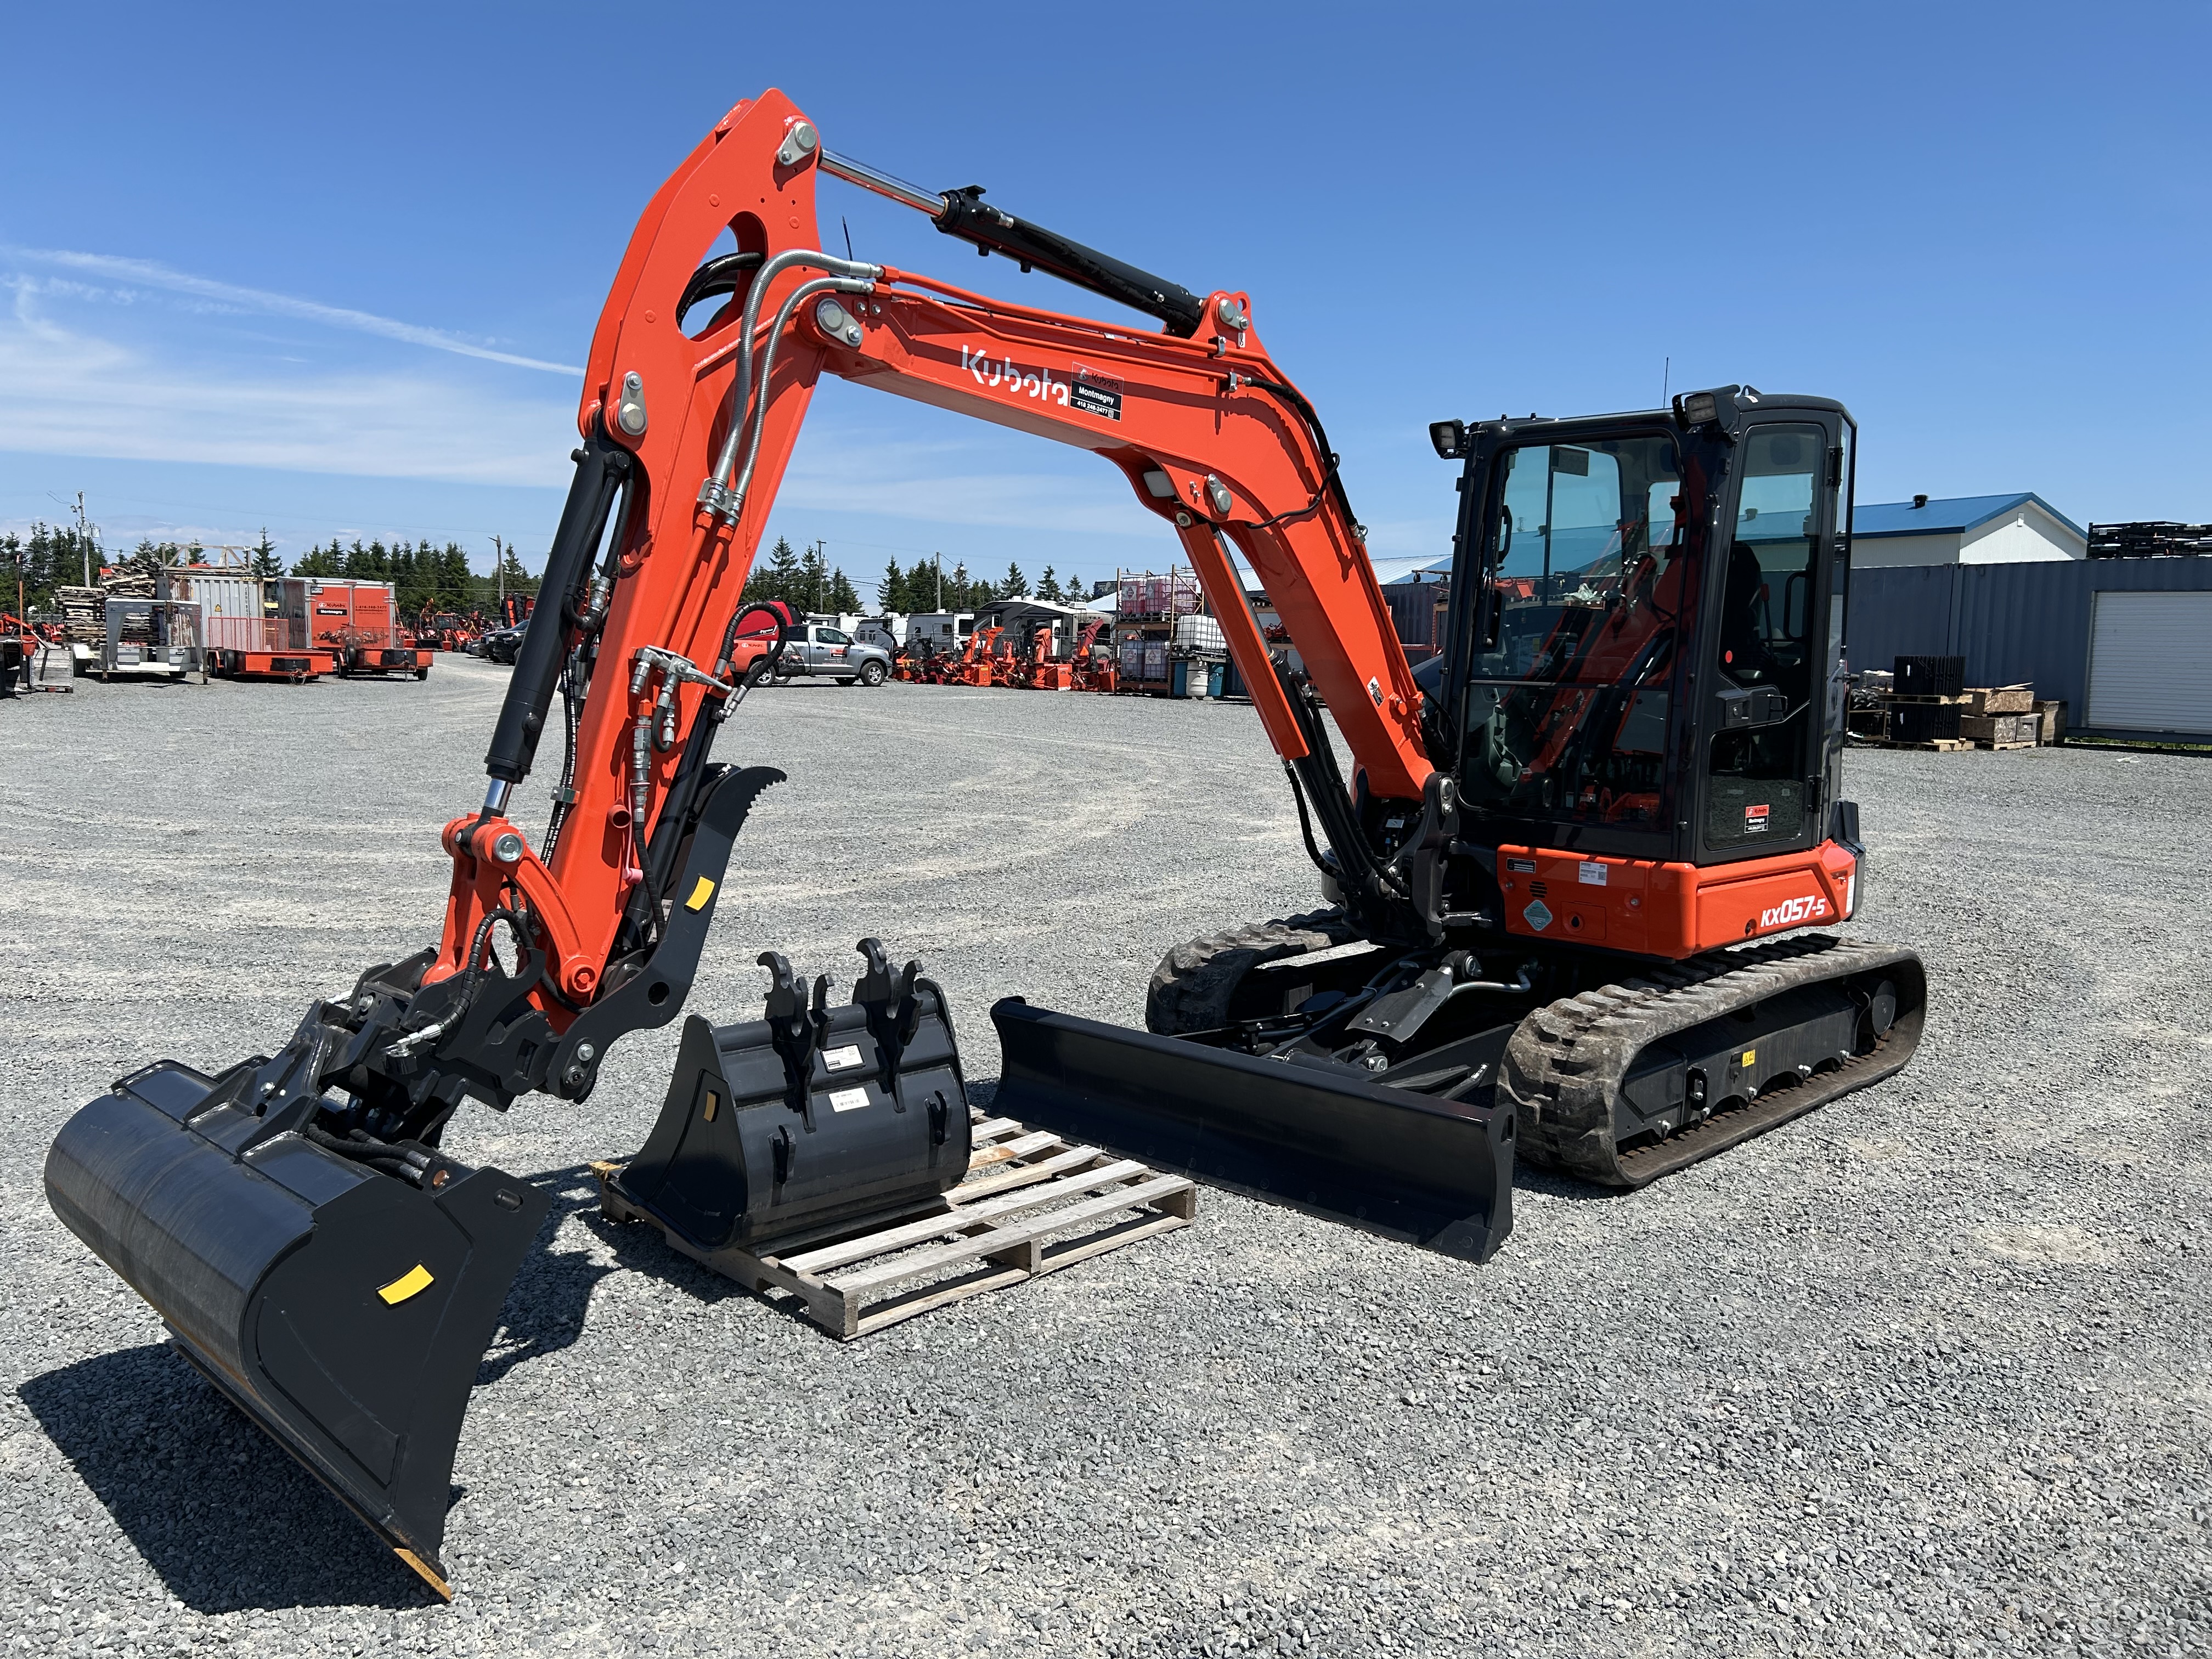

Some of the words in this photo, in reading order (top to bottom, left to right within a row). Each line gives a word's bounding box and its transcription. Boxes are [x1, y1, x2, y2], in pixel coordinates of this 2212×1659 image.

[961, 345, 1068, 407] Kubota
[1092, 373, 1119, 389] Kubota
[1079, 386, 1114, 405] Montmagny
[1760, 895, 1826, 927] KX057-5
